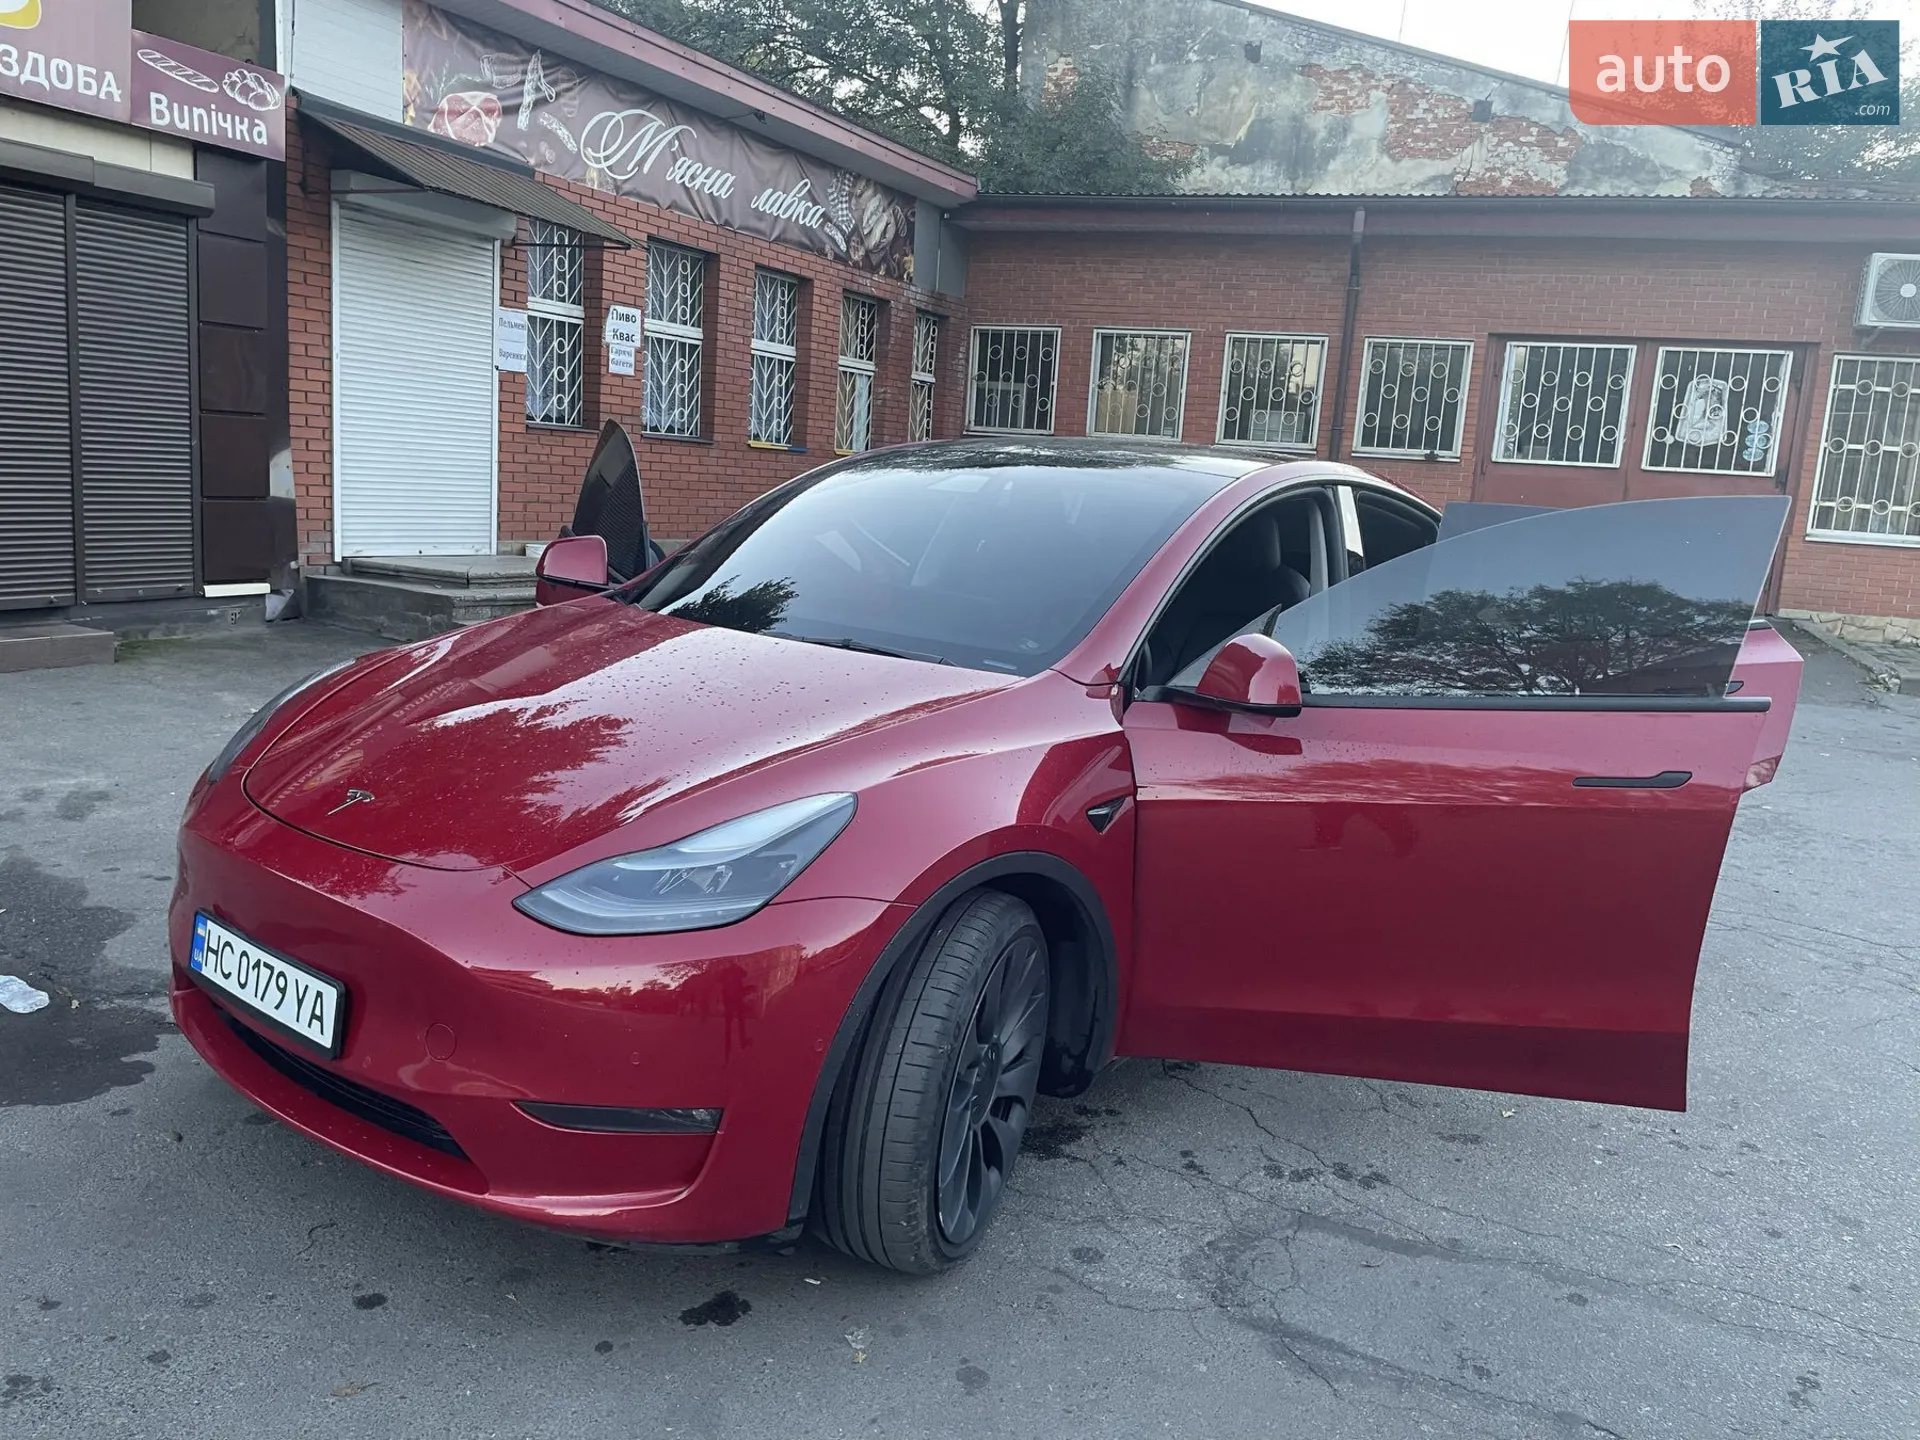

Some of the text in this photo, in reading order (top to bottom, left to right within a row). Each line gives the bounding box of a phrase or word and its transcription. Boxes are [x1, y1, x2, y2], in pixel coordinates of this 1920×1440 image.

[0, 44, 121, 102] ЗДОБА
[150, 92, 268, 145] Випічка
[752, 178, 826, 230] лавка
[611, 308, 637, 324] Пиво
[612, 328, 635, 343] Квас
[237, 950, 288, 1011] 0179
